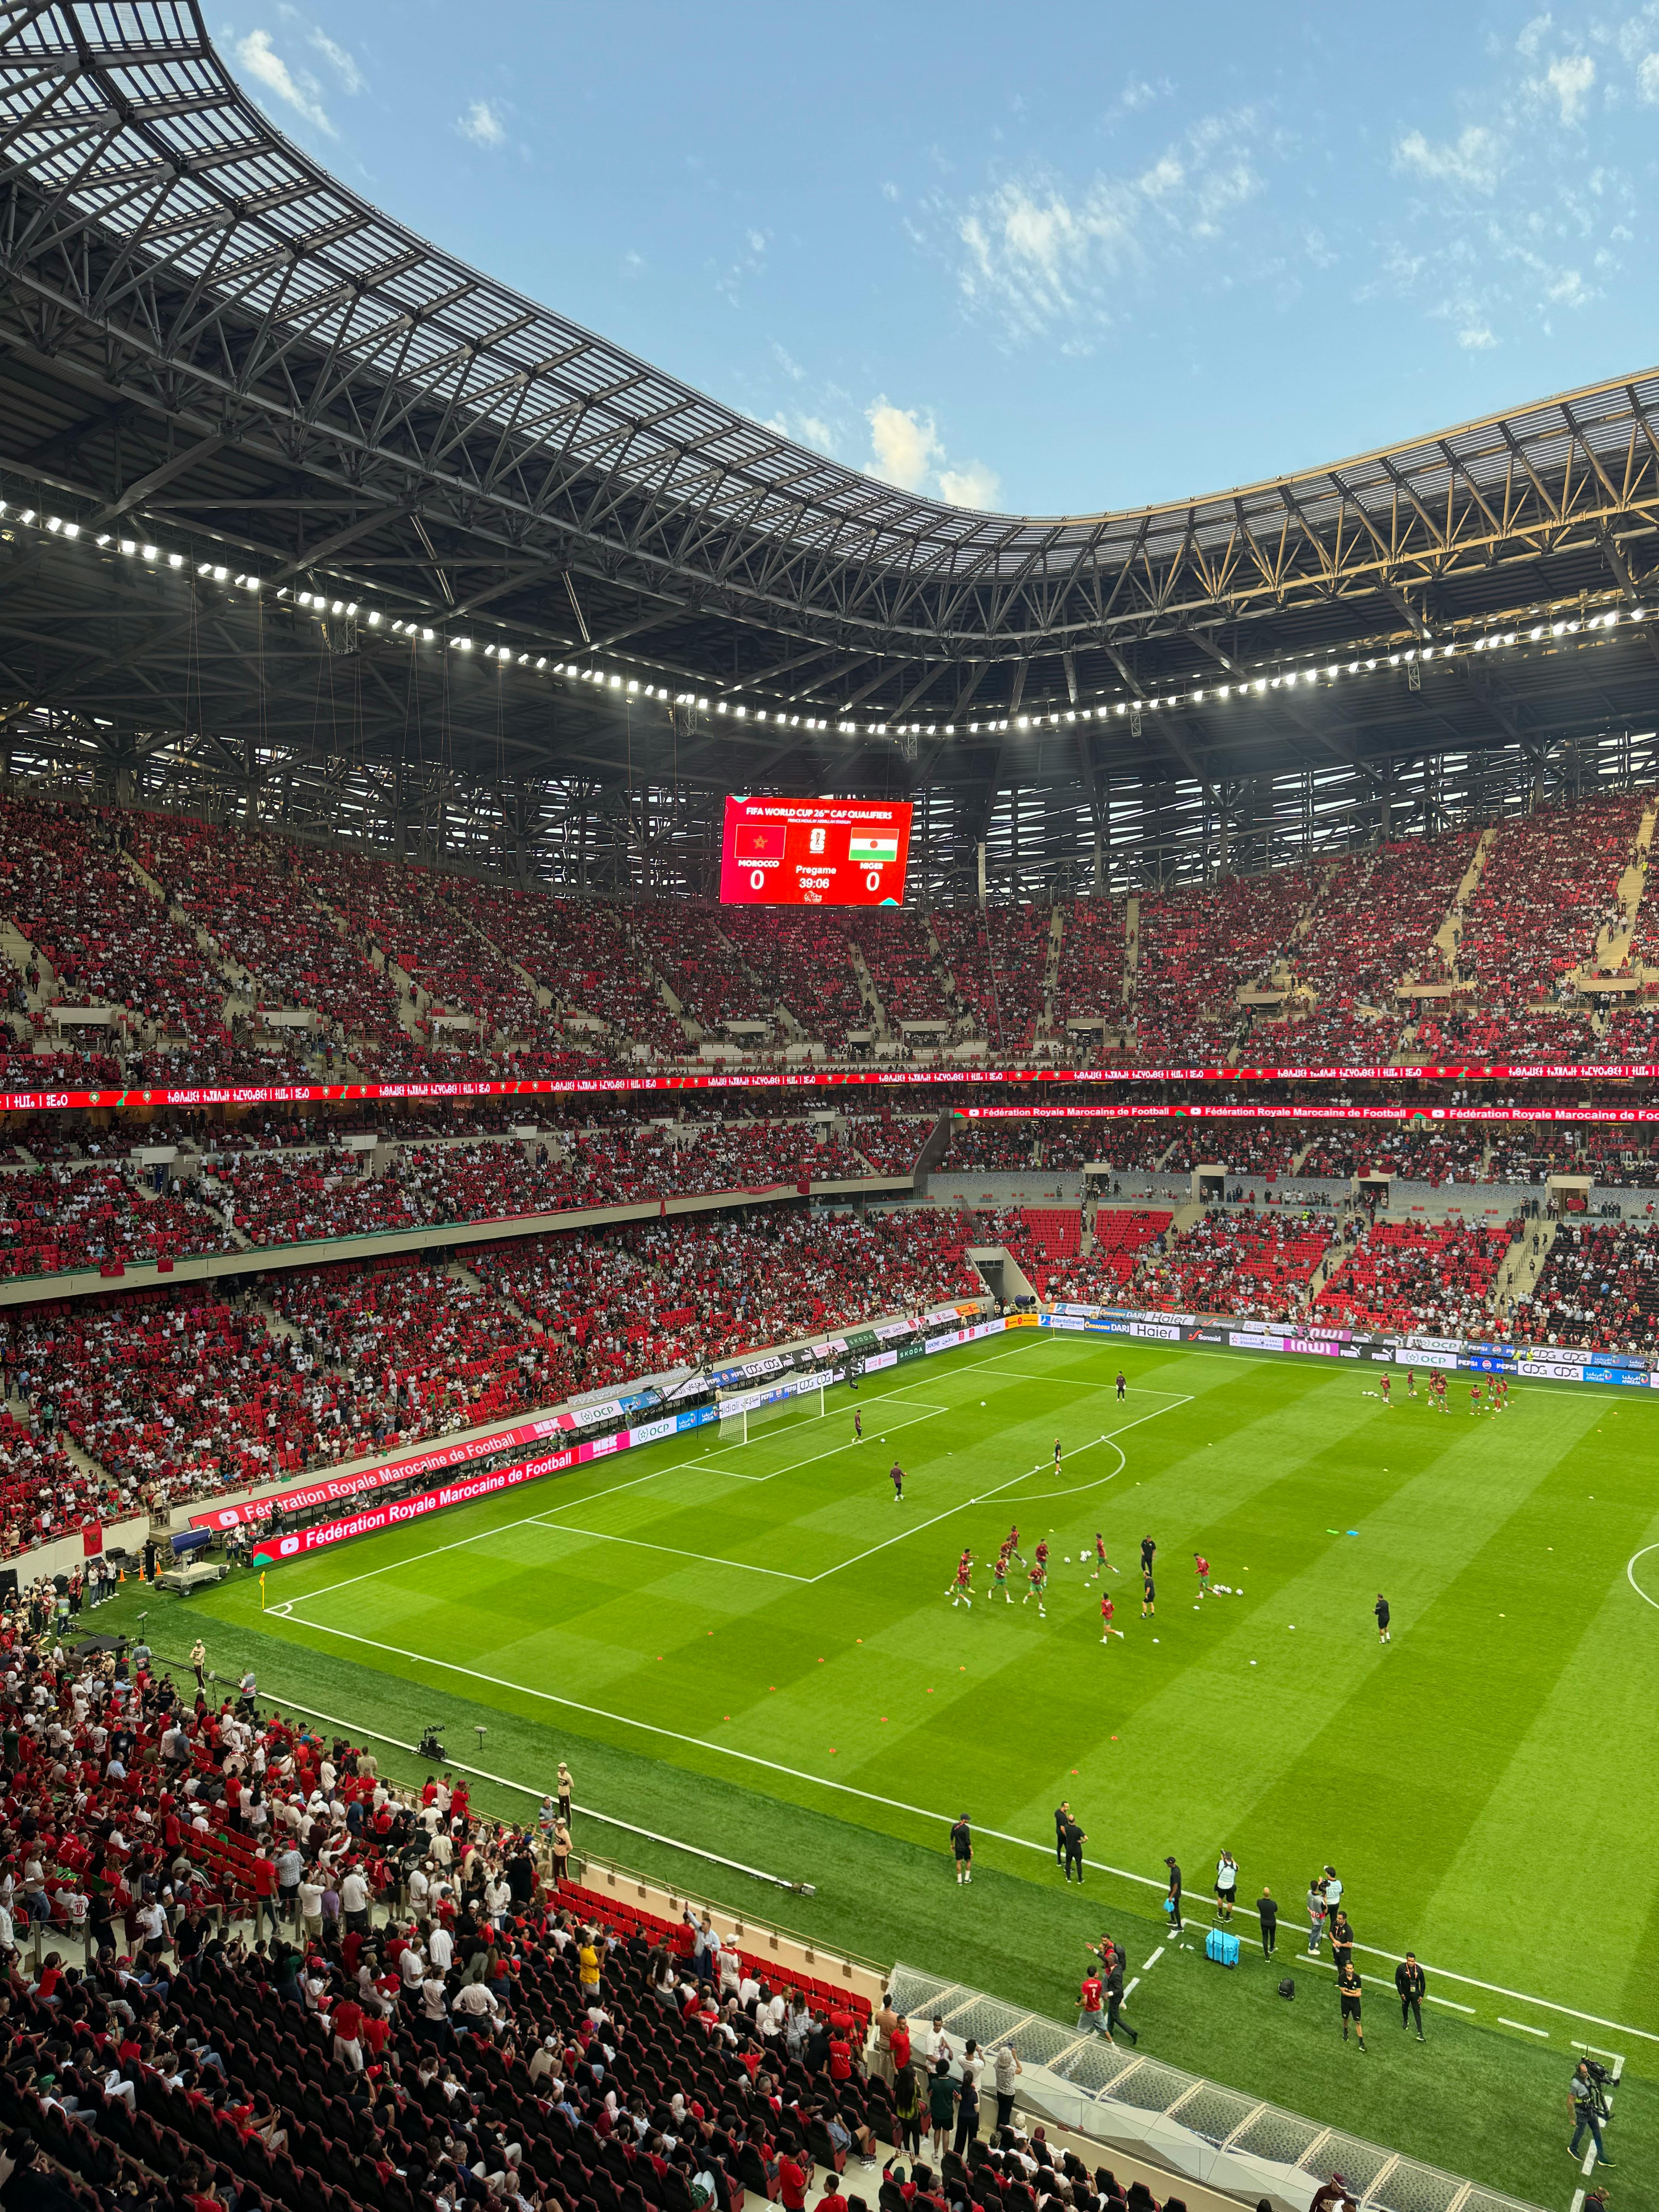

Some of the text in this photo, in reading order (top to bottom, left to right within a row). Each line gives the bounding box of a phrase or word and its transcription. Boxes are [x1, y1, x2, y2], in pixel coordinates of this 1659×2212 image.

[746, 807, 764, 815] FIFA
[765, 808, 795, 817] WORLD
[796, 809, 812, 817] CUP
[847, 811, 892, 819] QUALIFIERS
[796, 865, 836, 876] Pregame
[750, 869, 764, 890] 0
[799, 878, 830, 889] 39:06
[866, 872, 880, 891] 0
[1034, 1108, 1064, 1117] Royale
[1067, 1108, 1115, 1116] Marocaine
[1205, 1108, 1406, 1117] Fédération Royale Marocaine de Football
[1449, 1109, 1509, 1118] Fédération
[1512, 1110, 1552, 1120] Royale
[1555, 1110, 1616, 1119] Marocaine
[1620, 1111, 1635, 1119] de
[1126, 1311, 1145, 1320] DARI
[1151, 1312, 1188, 1325] Haier
[1085, 1321, 1110, 1330] Couscous
[1111, 1324, 1130, 1333] DARI
[1137, 1325, 1172, 1338] Haier
[1198, 1334, 1221, 1342] Sonasid
[1310, 1328, 1343, 1340] nwi
[1291, 1341, 1331, 1354] inwi
[1432, 1341, 1457, 1349] OCP
[1421, 1355, 1446, 1364] OCP
[1532, 1350, 1587, 1362] CDG CDG
[746, 1363, 763, 1374] CDG
[764, 1358, 781, 1369] CDG
[1522, 1364, 1579, 1378] CDG CDG
[706, 1369, 744, 1385] PEPSI PEPSI
[799, 1379, 814, 1390] CDG
[817, 1373, 831, 1384] CDG
[761, 1385, 797, 1401] PEPSI PEPSI
[593, 1406, 613, 1418] OCP
[649, 1423, 669, 1436] OCP
[328, 1475, 377, 1499] Royale
[379, 1456, 447, 1482] Marocaine
[450, 1449, 465, 1461] de
[466, 1433, 515, 1456] Football
[306, 1513, 385, 1547] Fédération
[390, 1496, 436, 1520] Royale
[440, 1475, 505, 1505] Marocaine
[508, 1469, 522, 1483] de
[526, 1452, 572, 1477] Football
[75, 1904, 84, 1914] 10
